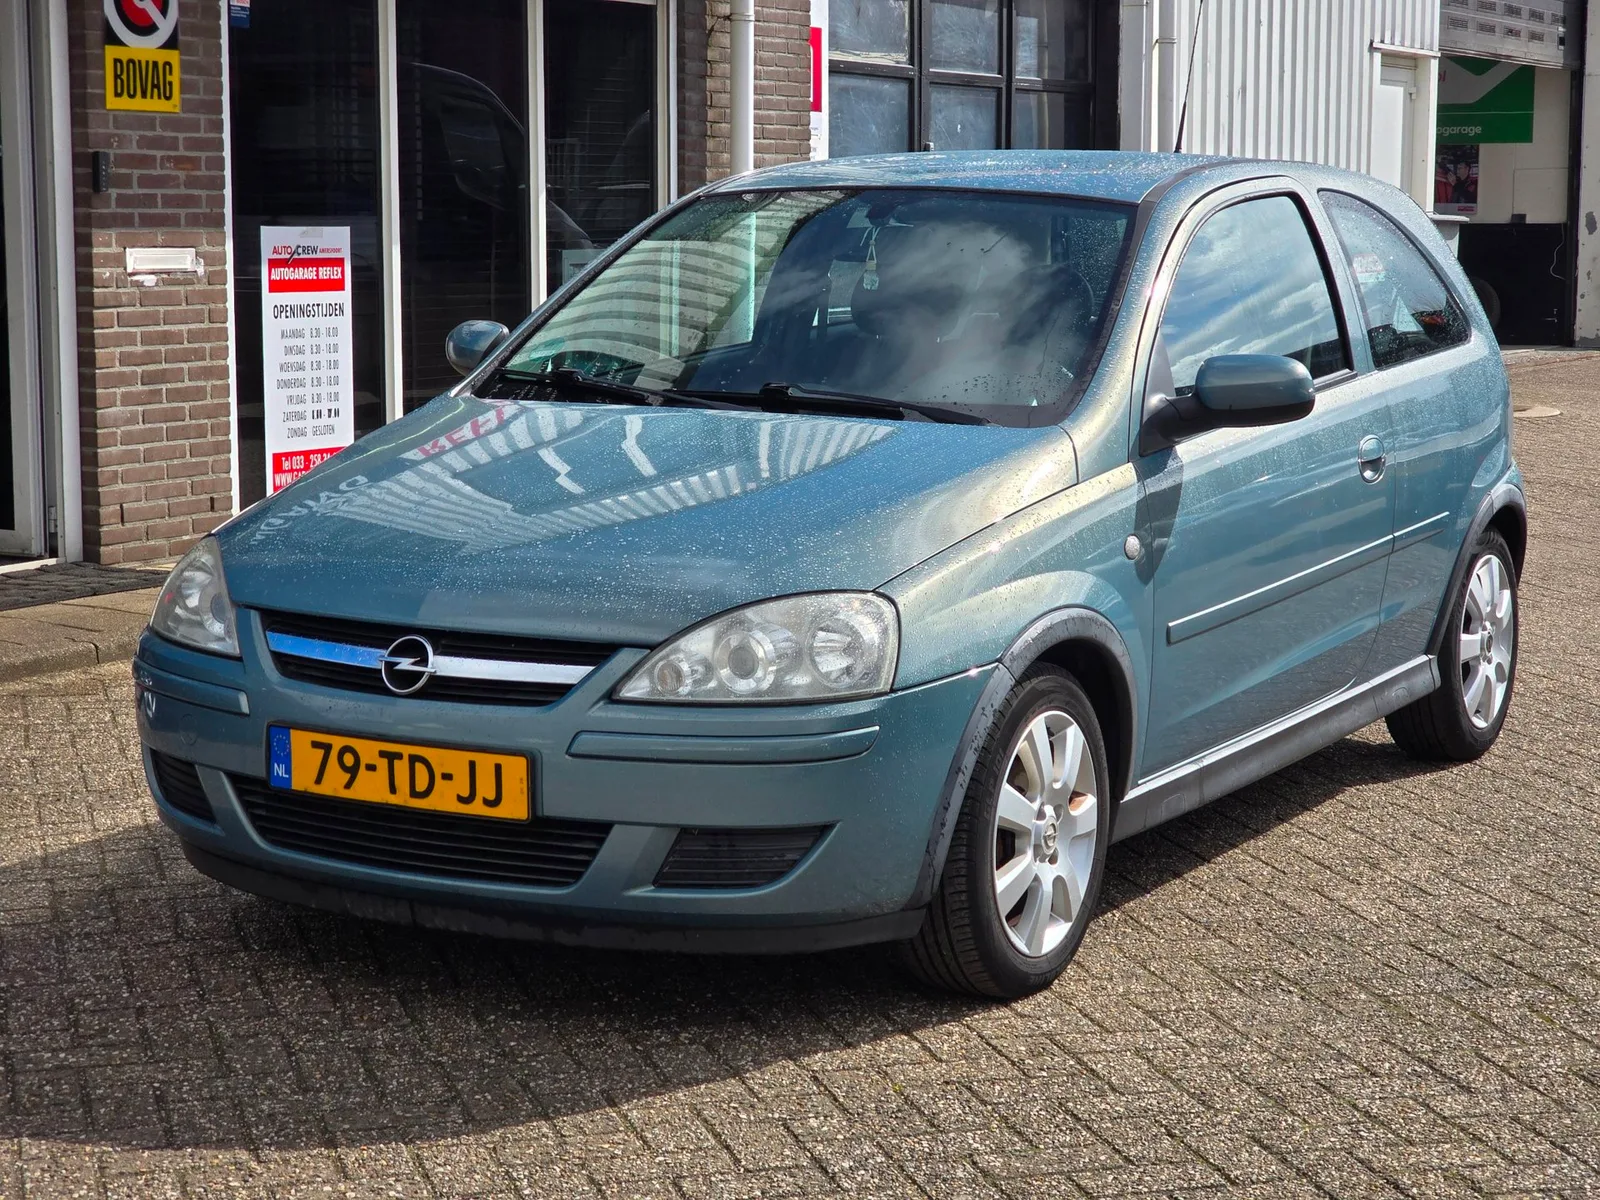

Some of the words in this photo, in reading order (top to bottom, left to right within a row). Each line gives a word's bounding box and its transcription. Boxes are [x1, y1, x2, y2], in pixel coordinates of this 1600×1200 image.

[113, 57, 173, 100] BOVAG
[271, 267, 317, 280] AUTOGARAGE
[319, 267, 342, 279] REFLEX
[273, 303, 345, 319] OPENINGSTIJDEN
[281, 328, 305, 339] MAANDAG
[284, 344, 305, 356] DINSDAG
[279, 361, 306, 372] WOENSDAG
[277, 377, 306, 389] DONDERDAG
[286, 393, 306, 405] VRIJDAG
[283, 410, 307, 422] ZATERDAG
[287, 426, 307, 438] ZONDAG
[312, 424, 335, 436] GESLOTEN
[282, 457, 291, 470] Tel
[292, 455, 304, 469] 033
[274, 763, 289, 778] NL
[311, 740, 503, 808] 79-TD-JJ
